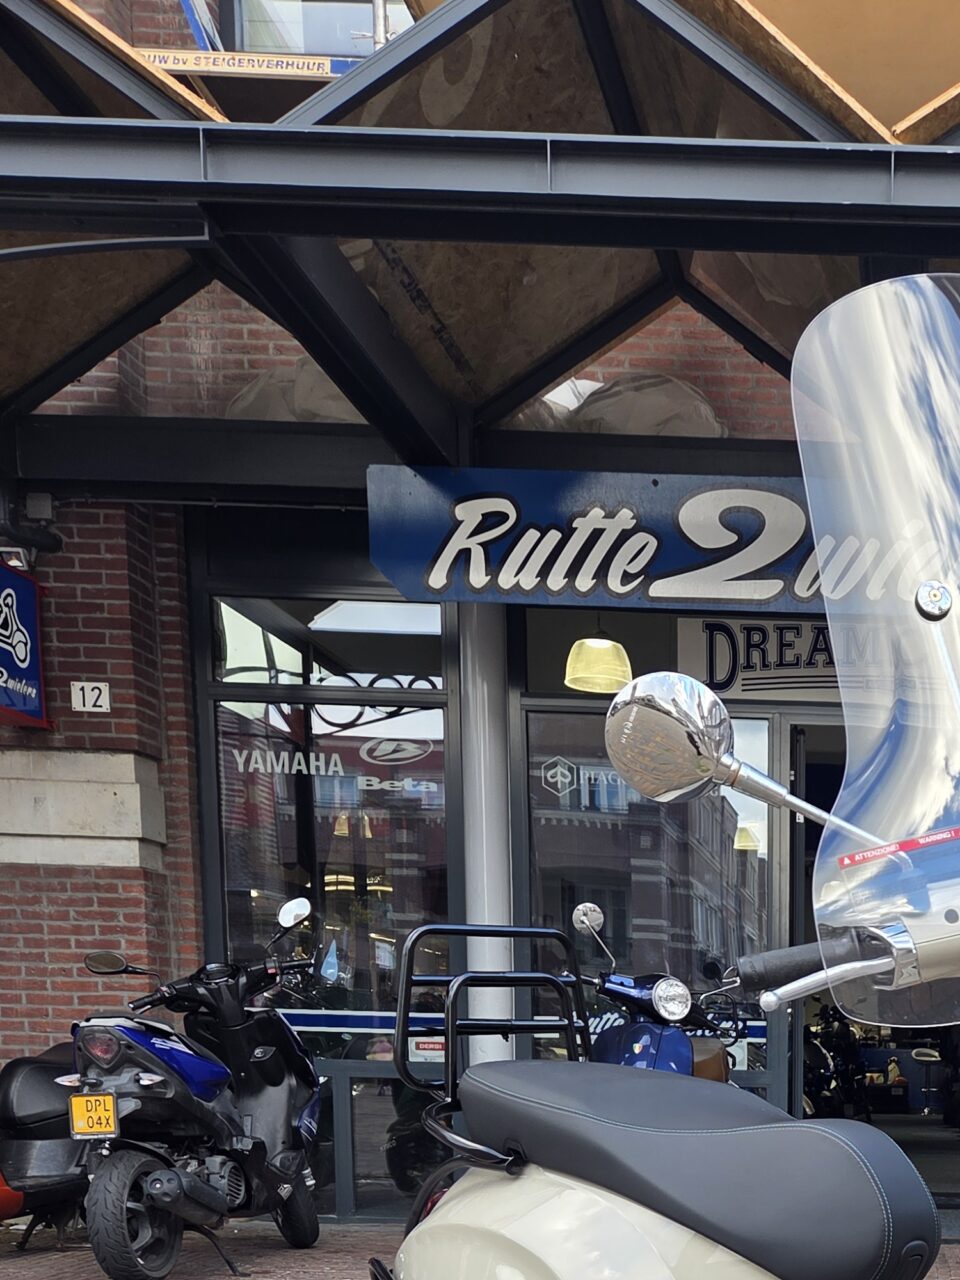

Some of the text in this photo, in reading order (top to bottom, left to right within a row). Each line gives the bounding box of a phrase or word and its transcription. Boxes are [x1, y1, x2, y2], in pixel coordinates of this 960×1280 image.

[193, 56, 326, 72] STEIGERVERHUUR
[427, 497, 659, 594] Rutte
[702, 620, 883, 692] DREAM
[79, 685, 104, 708] 12
[231, 749, 345, 777] YAMAHA
[357, 776, 438, 792] Beta
[85, 1099, 111, 1113] DPL
[86, 1115, 112, 1129] 04X
